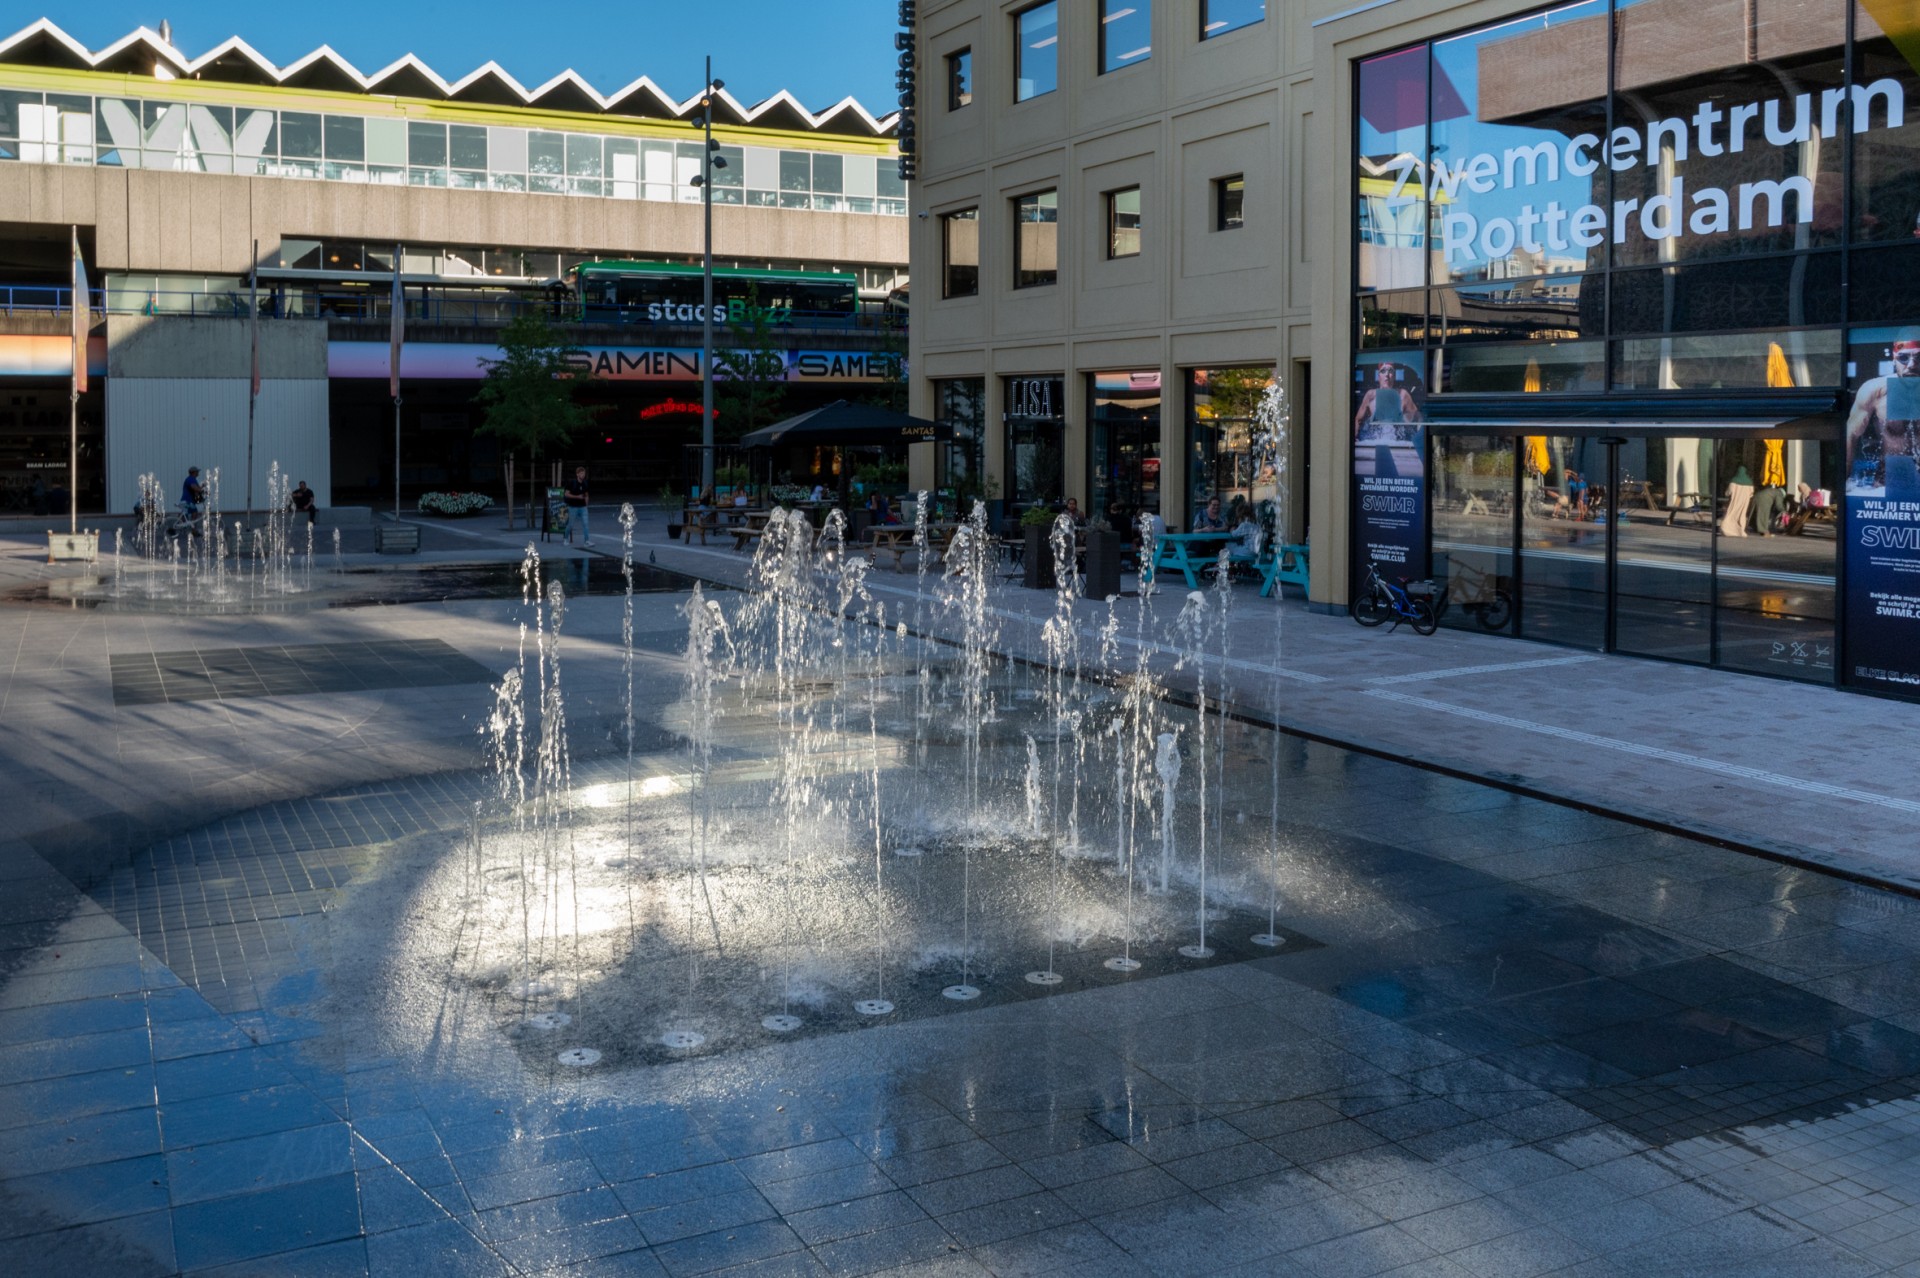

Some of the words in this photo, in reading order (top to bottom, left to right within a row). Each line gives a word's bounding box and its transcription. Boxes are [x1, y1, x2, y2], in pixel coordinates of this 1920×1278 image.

[1386, 78, 1904, 208] Zwemcentrum
[1444, 176, 1813, 263] Rotterdam
[560, 351, 700, 375] SAMEN
[1012, 381, 1052, 416] LISA
[901, 427, 935, 435] SANTAS
[1362, 495, 1415, 513] SWIMR
[1864, 500, 1884, 510] WIL
[1885, 501, 1897, 512] JIJ
[1900, 502, 1920, 511] EEN
[1856, 510, 1911, 521] ZWEMMER
[1870, 592, 1889, 600] Bekijk
[1856, 666, 1887, 680] ELKE
